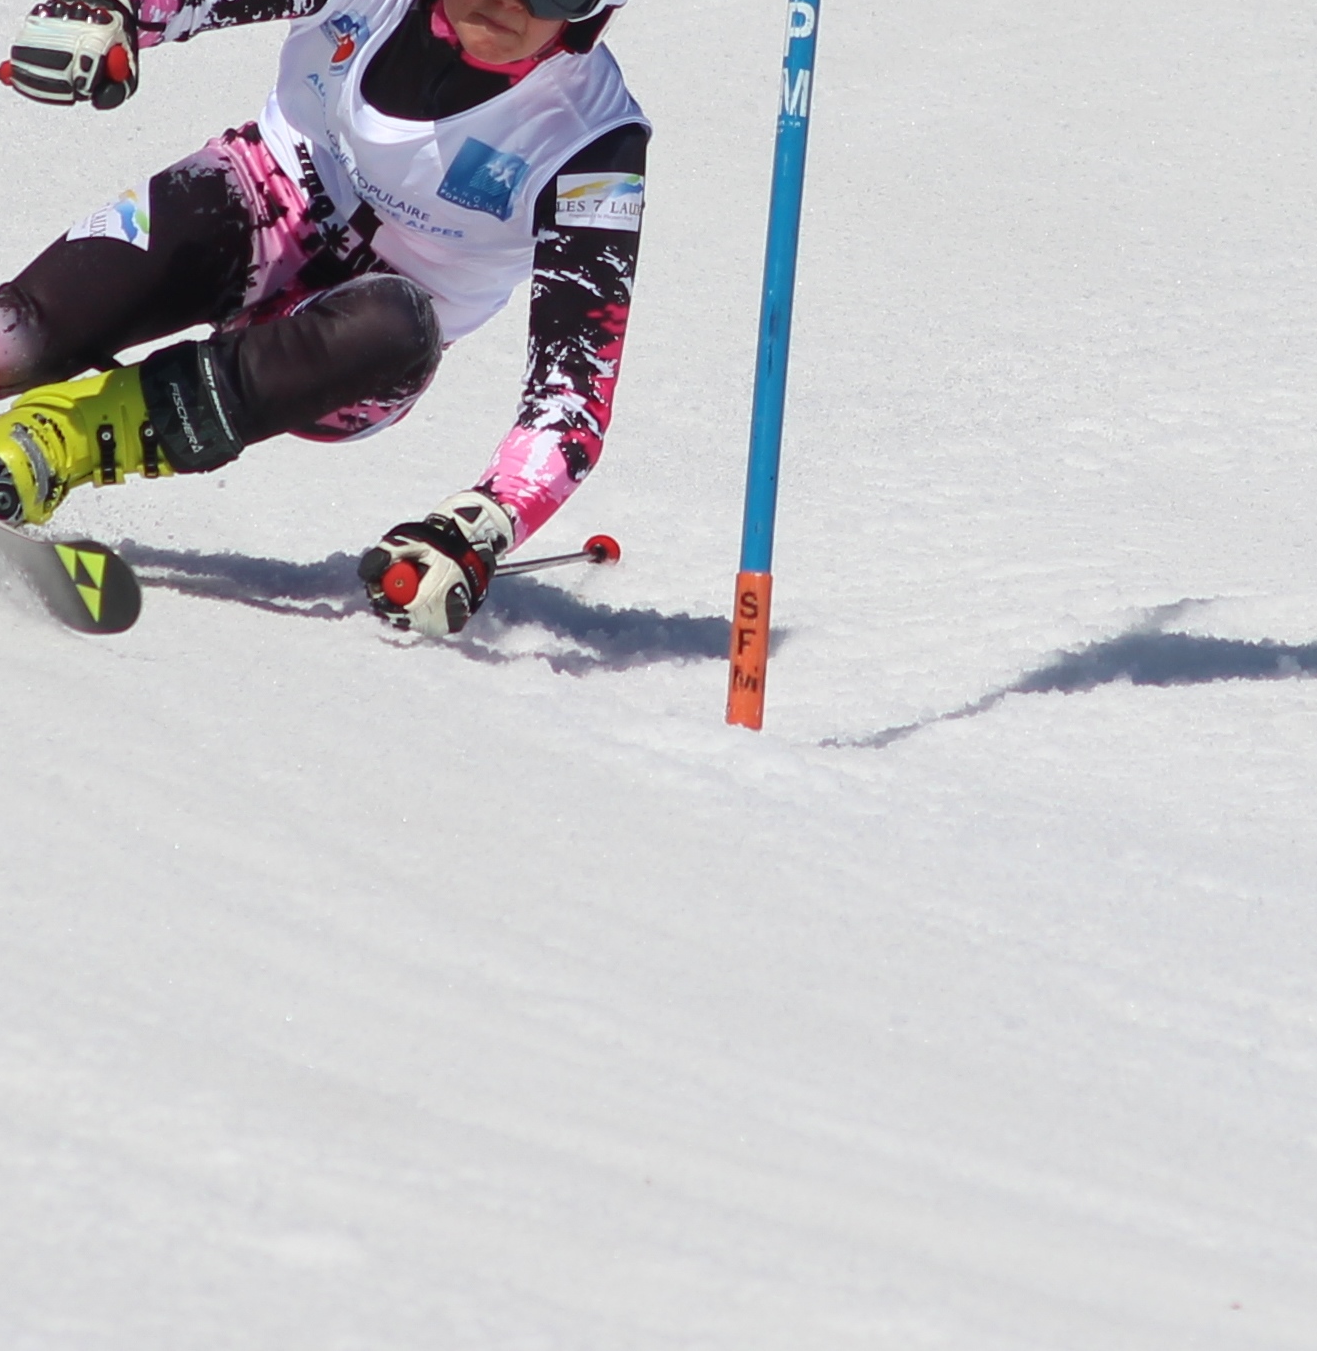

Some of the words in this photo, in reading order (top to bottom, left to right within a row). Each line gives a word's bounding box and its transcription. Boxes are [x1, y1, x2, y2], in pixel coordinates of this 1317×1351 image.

[350, 166, 432, 223] POPULAIRE
[556, 199, 586, 213] LES
[593, 199, 604, 213] 7
[168, 382, 198, 445] FISCHER
